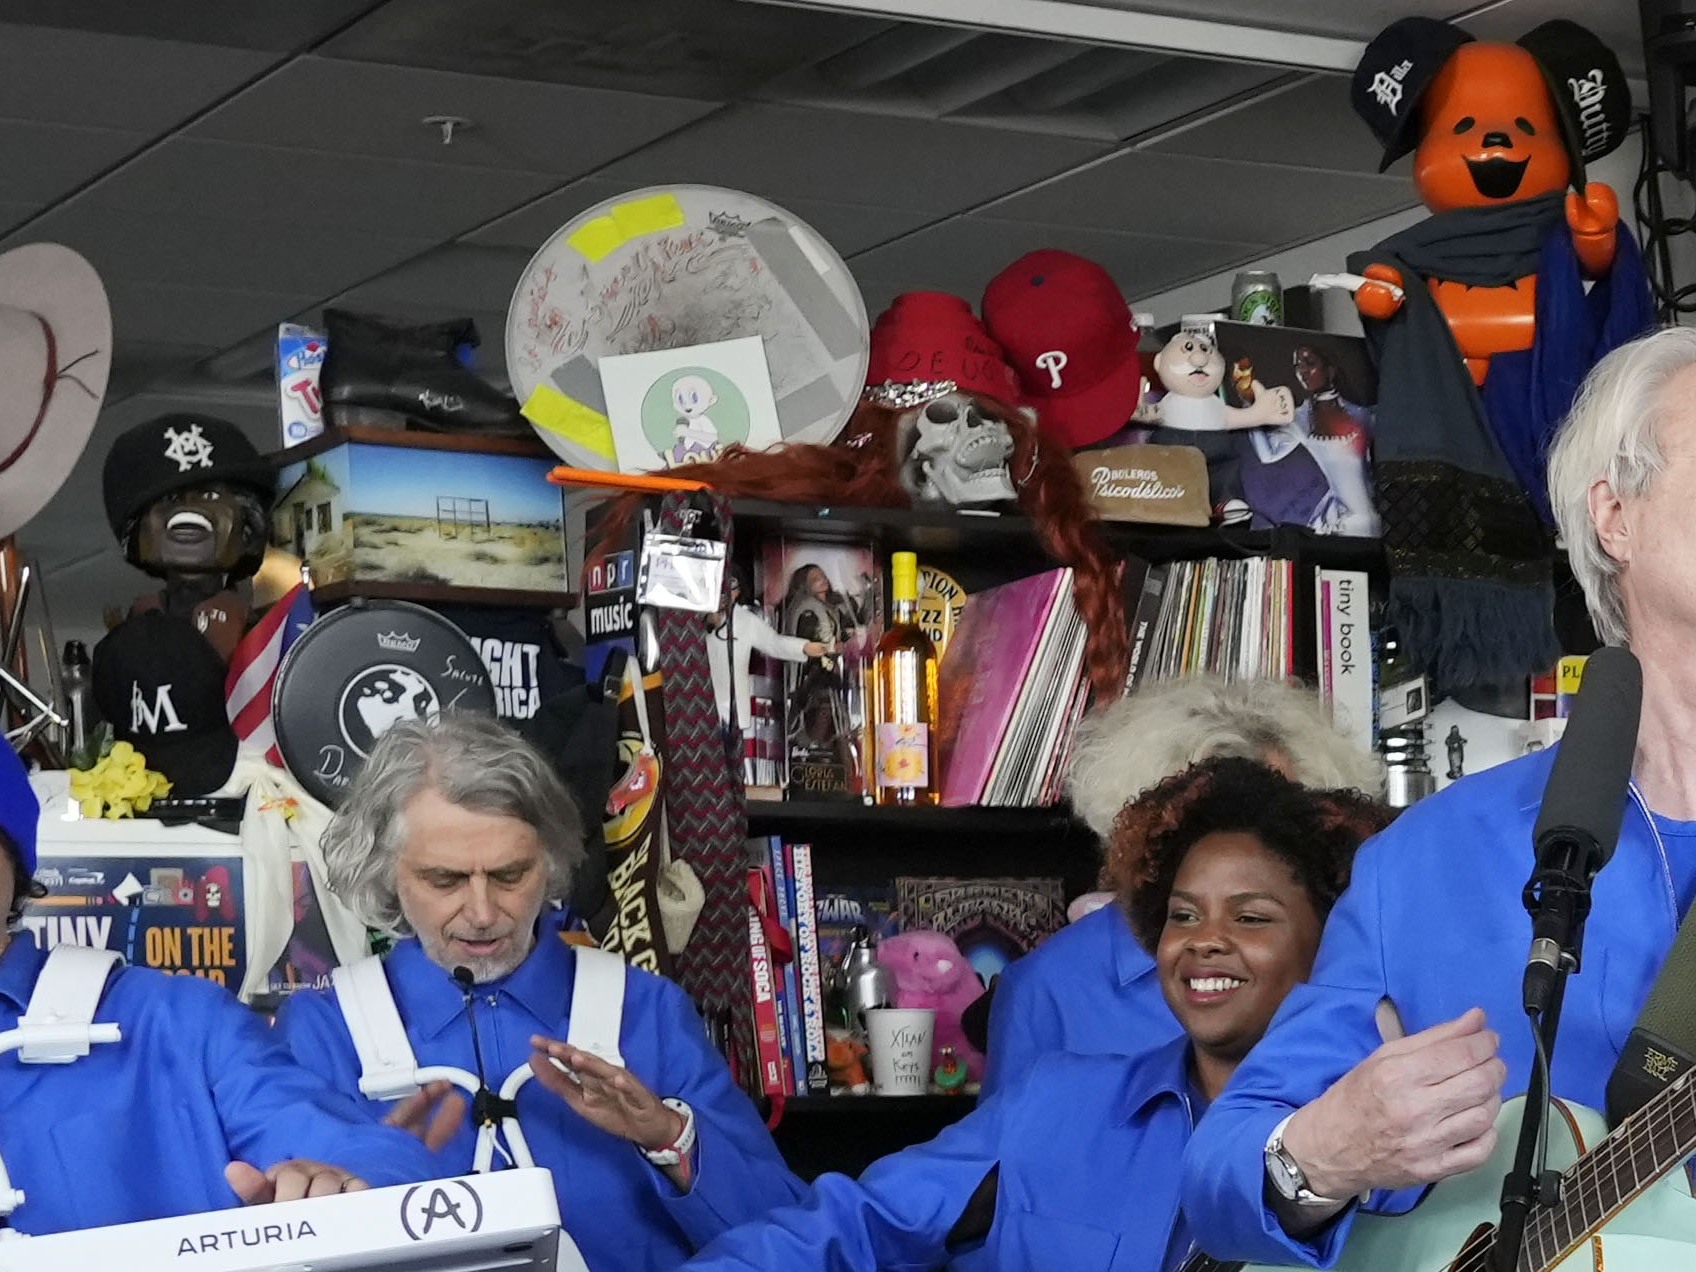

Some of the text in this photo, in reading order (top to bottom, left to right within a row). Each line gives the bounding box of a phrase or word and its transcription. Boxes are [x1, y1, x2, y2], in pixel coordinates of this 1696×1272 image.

[591, 596, 634, 635] music
[1339, 577, 1357, 675] tiny book
[21, 916, 112, 951] TINY
[146, 927, 236, 967] ON THE
[177, 1219, 317, 1257] ARTURIA
